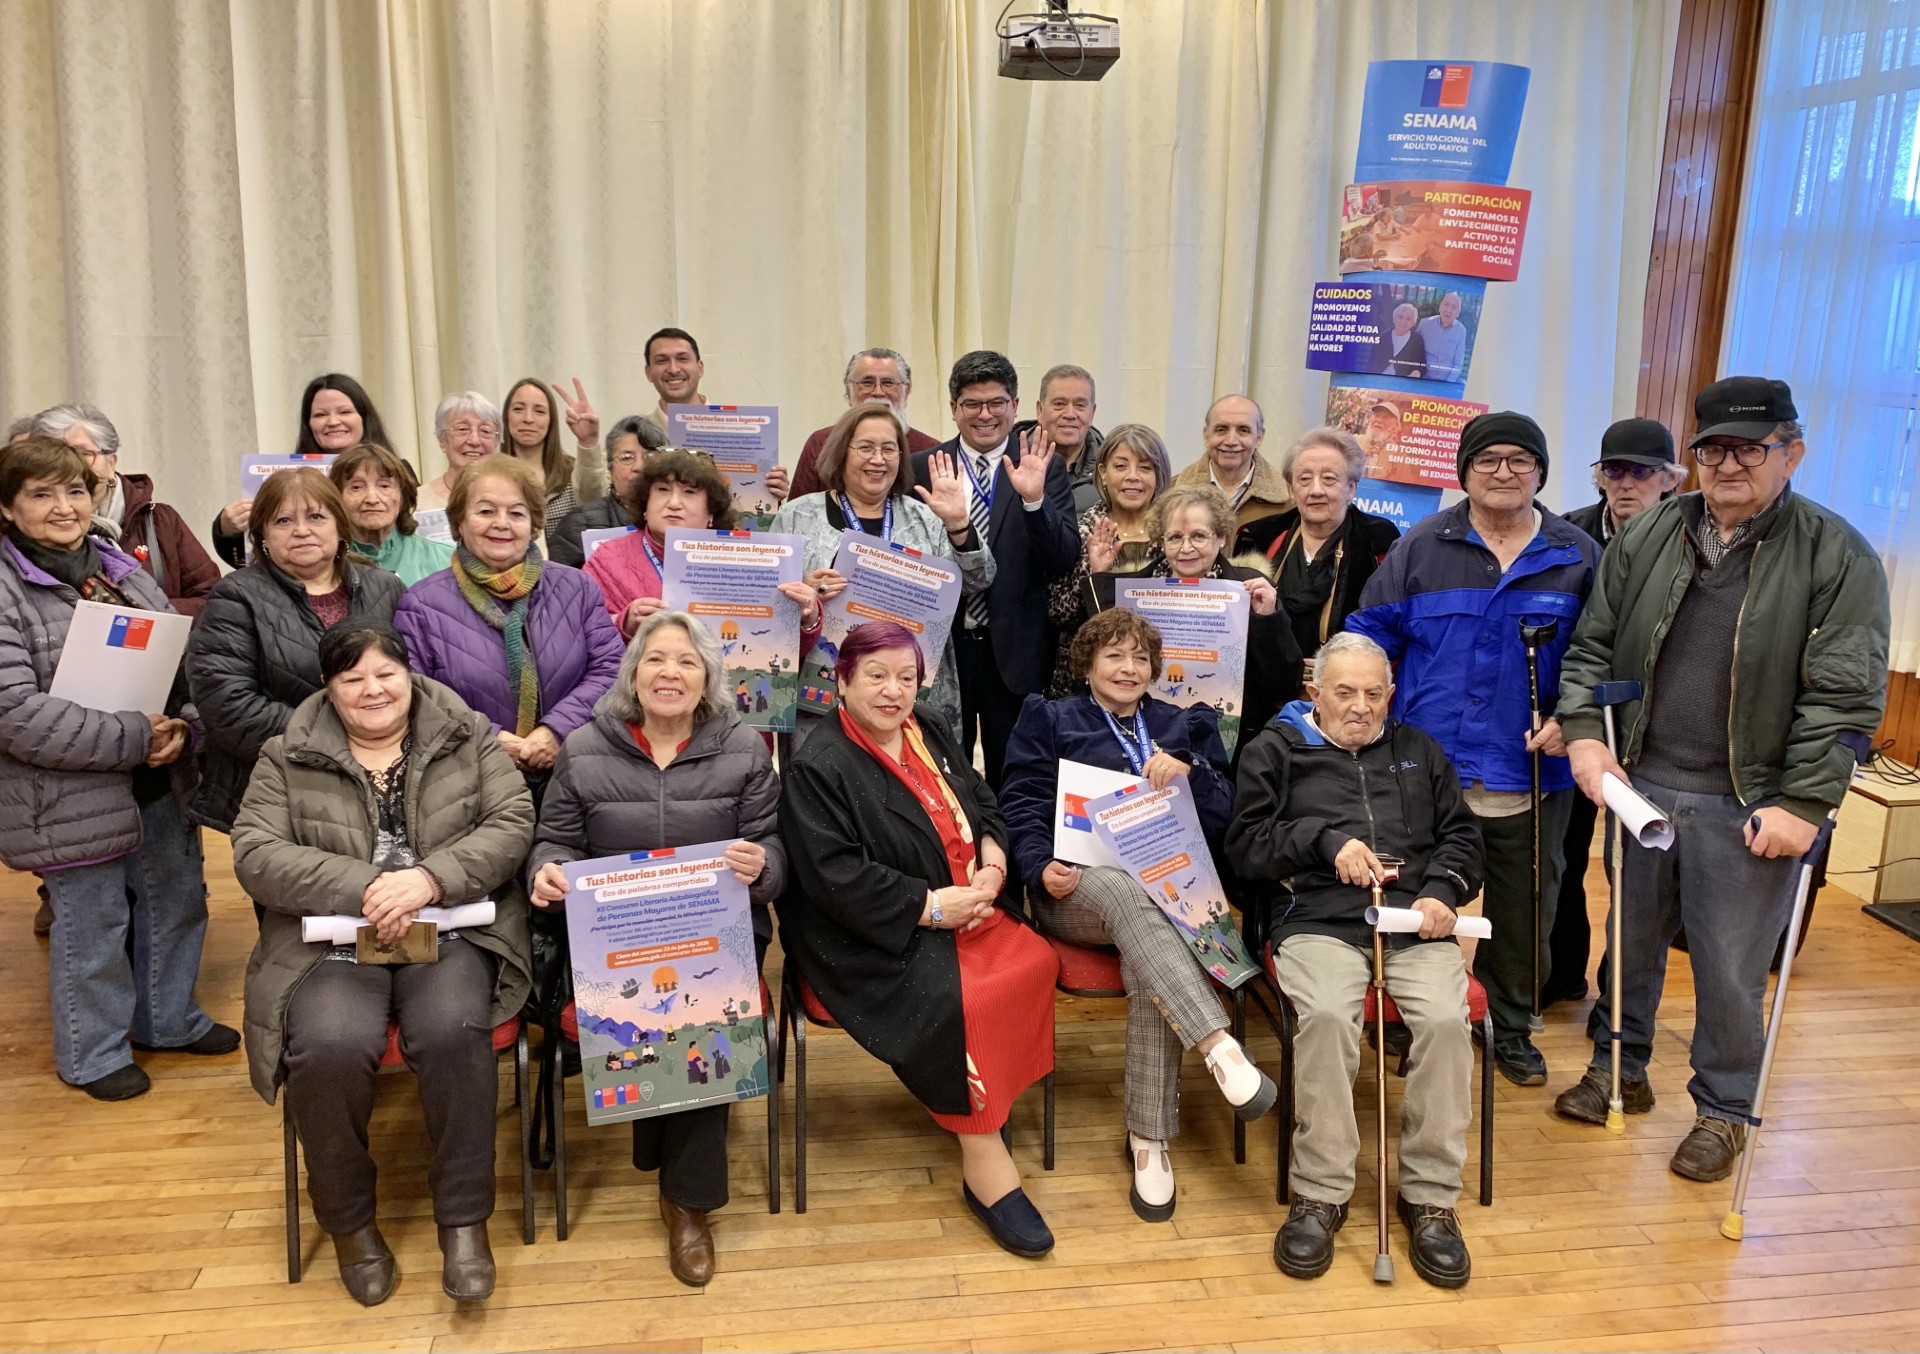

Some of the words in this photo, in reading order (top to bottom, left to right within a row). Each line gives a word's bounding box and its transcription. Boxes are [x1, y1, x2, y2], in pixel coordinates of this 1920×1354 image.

[1403, 113, 1477, 131] SENAMA
[1388, 134, 1425, 142] SERVICIO
[1427, 135, 1469, 144] NACIONAL
[1472, 138, 1487, 147] DEL
[1403, 143, 1436, 151] ADULTO
[1438, 144, 1468, 153] MAYOR
[1424, 192, 1521, 210] PARTICIPACIÓN
[1444, 208, 1508, 222] FOMENTAMOS
[1510, 216, 1520, 224] EL
[1439, 219, 1518, 234] ENVEJECIMIENTO
[1463, 232, 1498, 242] ACTIVO
[1506, 237, 1516, 245] LA
[1445, 240, 1514, 255] PARTICIPACIÓN
[1482, 255, 1512, 265] SOCIAL
[1316, 289, 1372, 300] CUIDADOS
[1314, 304, 1371, 313] PROMOVEMOS
[1313, 313, 1328, 321] UNA
[1329, 314, 1357, 322] MEJOR
[1311, 324, 1343, 332] CALIDAD
[1357, 325, 1379, 334] VIDA
[1335, 335, 1380, 344] PERSONAS
[1309, 343, 1343, 352] MAYORES
[1412, 399, 1482, 418] PROMOCIÓN
[1403, 412, 1419, 423] DE
[1422, 413, 1465, 430] DERECH
[1412, 426, 1460, 440] IMPULSAMO
[1401, 435, 1436, 447] CAMBIO
[1437, 440, 1460, 451] CULTU
[1386, 443, 1398, 452] EN
[1400, 446, 1430, 457] TORNO
[1438, 451, 1447, 459] LA
[1388, 455, 1403, 464] SIN
[1405, 456, 1457, 471] DISCRIMINAC
[1420, 469, 1428, 477] NI
[1429, 470, 1459, 481] EDADIS
[681, 542, 696, 550] Tus
[697, 542, 735, 552] historias
[752, 546, 786, 555] leyenda
[855, 544, 868, 555] Tus
[870, 548, 903, 565] historias
[904, 561, 918, 571] son
[919, 565, 950, 580] leyenda
[879, 563, 903, 575] palabras
[859, 575, 883, 587] Personas
[884, 582, 906, 595] Mayores
[1146, 590, 1183, 598] historias
[1200, 591, 1233, 601] leyenda
[1169, 618, 1193, 626] Mayores
[1125, 743, 1139, 763] ADULTO
[1099, 810, 1111, 821] Tus
[1110, 802, 1133, 819] historias
[1133, 800, 1145, 810] son
[1144, 789, 1174, 807] leyenda
[585, 877, 605, 887] Tus
[607, 869, 656, 884] historias
[658, 866, 678, 876] son
[680, 860, 723, 875] leyenda
[602, 890, 615, 898] Eco
[628, 883, 661, 896] palabras
[662, 877, 709, 890] compartidas
[606, 901, 639, 911] Concurso
[640, 896, 668, 907] Literario
[669, 889, 719, 902] Autobiográfico
[608, 910, 643, 920] Personas
[644, 904, 676, 916] Mayores
[677, 902, 687, 910] de
[688, 897, 720, 909] SENAMA
